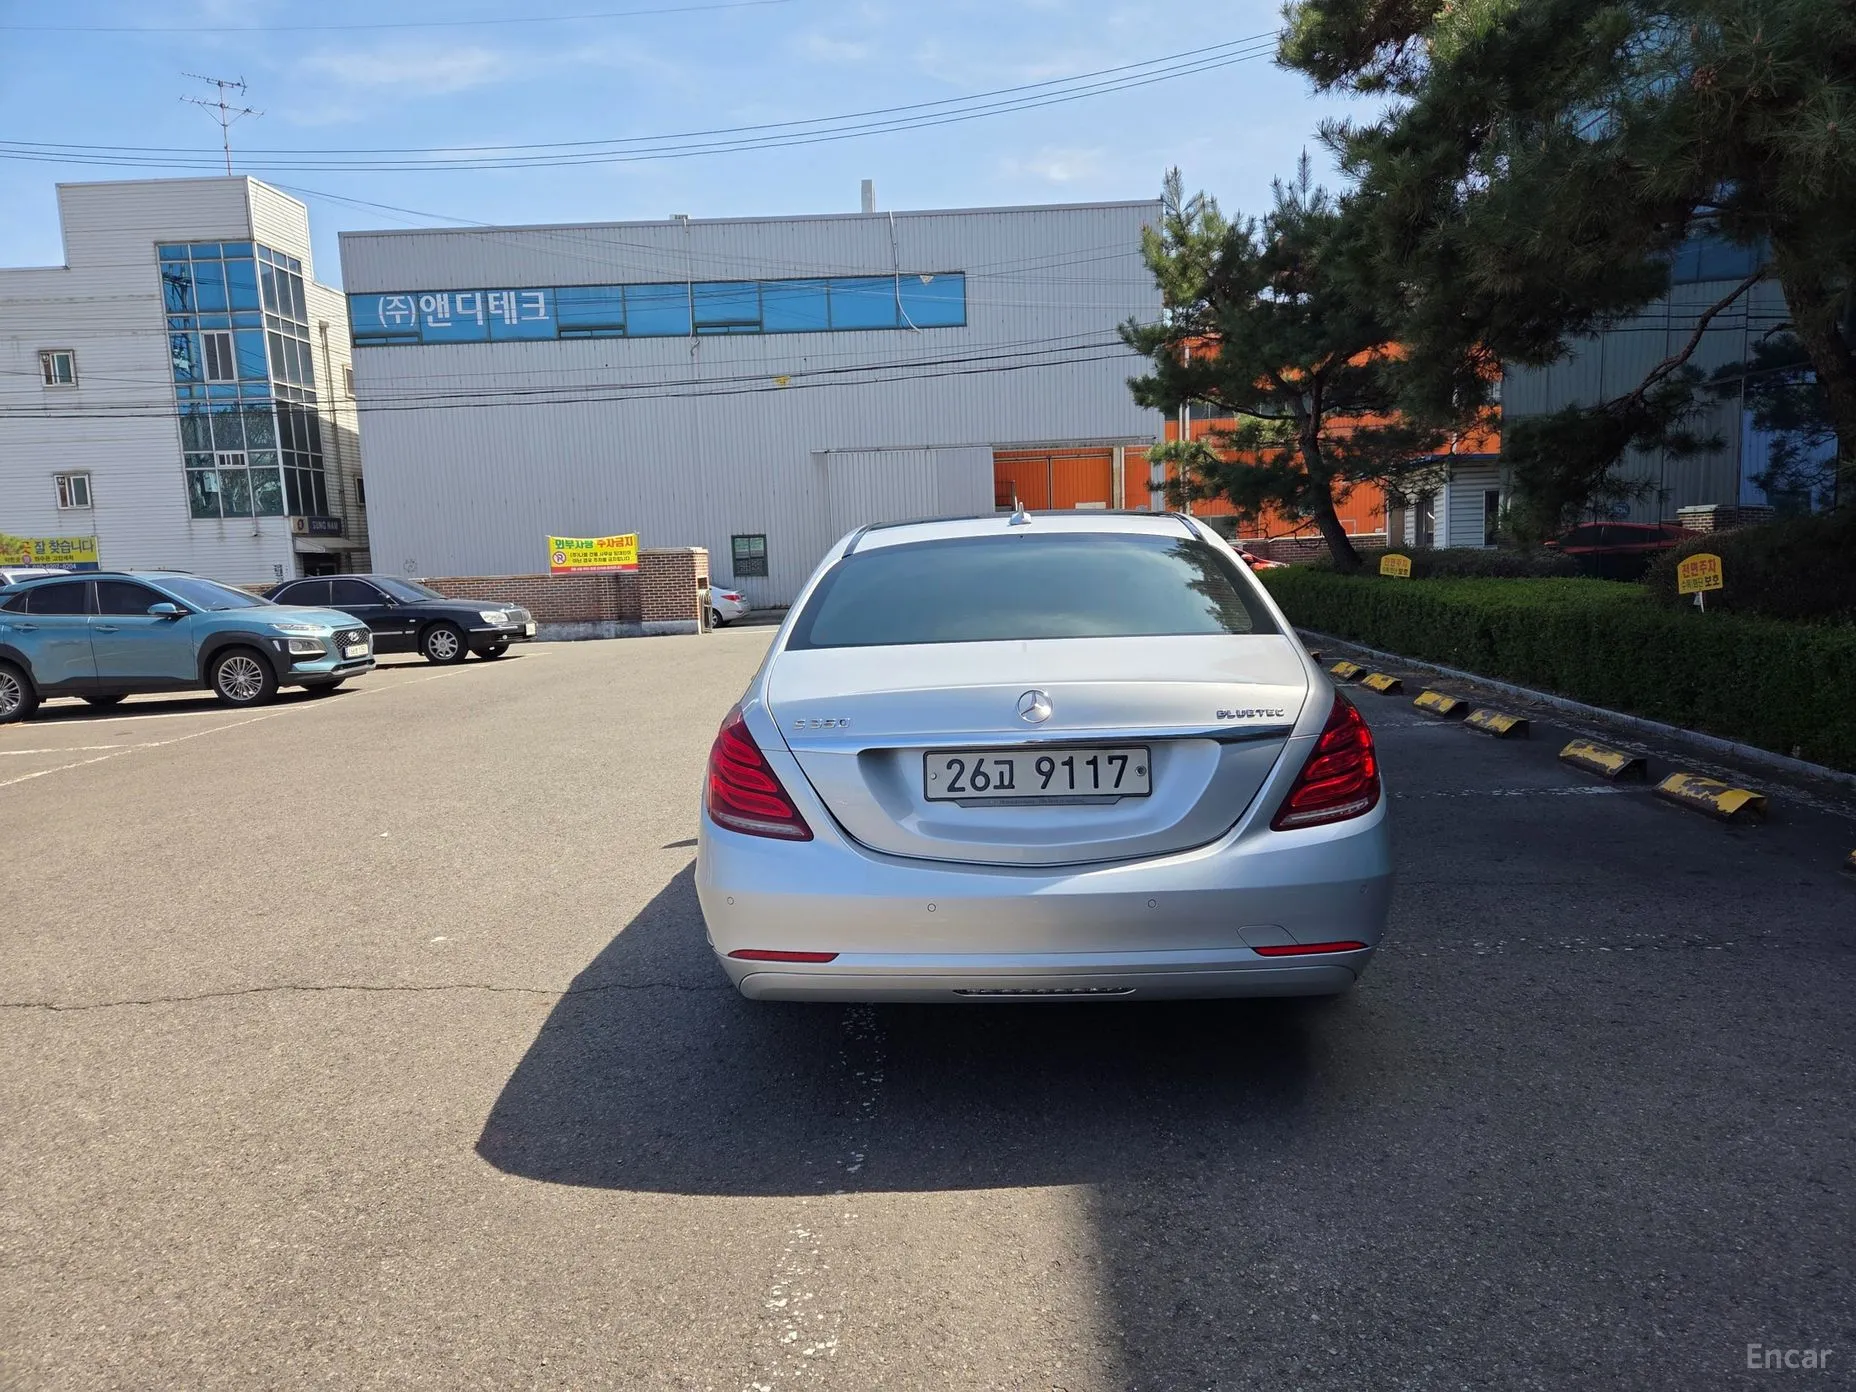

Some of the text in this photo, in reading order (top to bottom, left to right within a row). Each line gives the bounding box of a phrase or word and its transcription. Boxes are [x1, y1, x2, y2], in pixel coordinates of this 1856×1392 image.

[378, 291, 549, 328] (주)앤디테크
[35, 540, 45, 554] 잘
[49, 539, 94, 554] 찾습니다
[597, 536, 633, 548] 주차금지
[1704, 574, 1719, 587] 보호
[1216, 709, 1284, 719] BLUETEC
[794, 718, 851, 730] S 350
[946, 754, 1129, 792] 26고 9117
